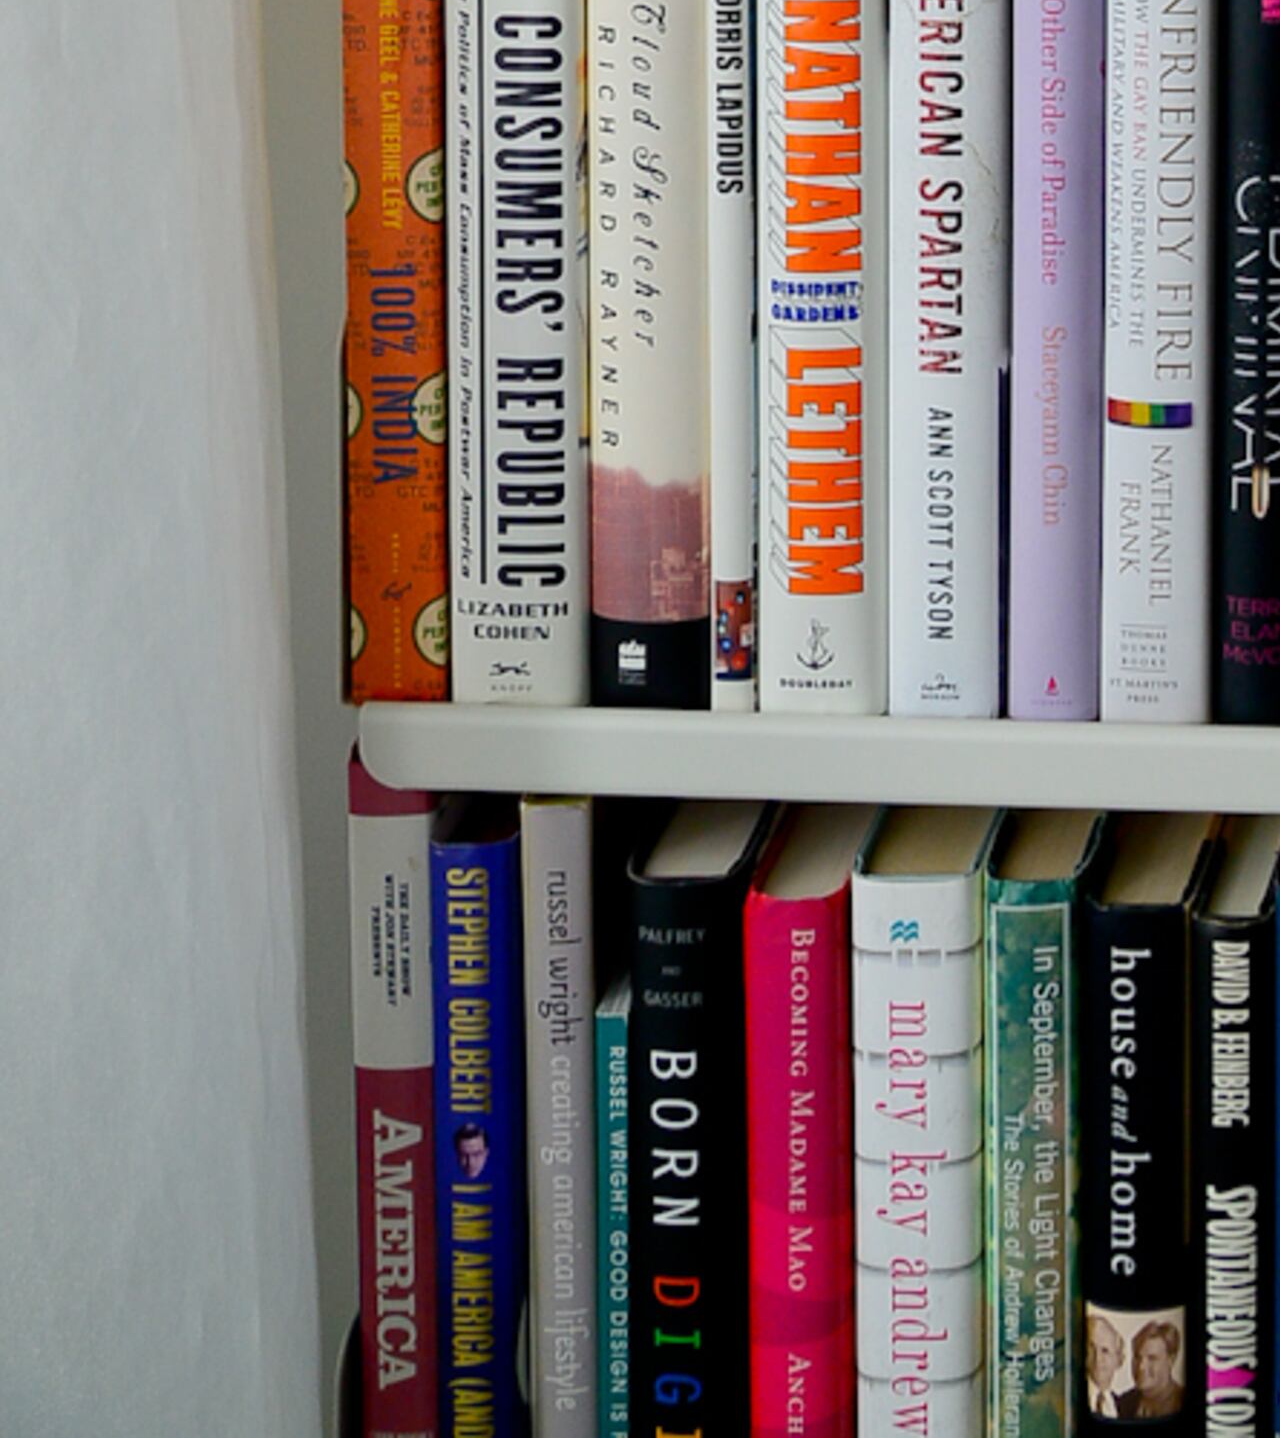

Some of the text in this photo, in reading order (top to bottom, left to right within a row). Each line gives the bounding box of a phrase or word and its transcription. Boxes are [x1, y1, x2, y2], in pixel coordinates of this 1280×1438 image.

[493, 16, 567, 334] CONSUMERS'
[715, 84, 745, 195] LAPIDUS
[495, 356, 567, 587] REPUBLIC
[928, 407, 953, 640] ANN SCOTT TYSON
[472, 623, 551, 642] COHEN
[445, 868, 492, 1115] STEPHEN COLBERT
[1108, 946, 1153, 1278] house and home
[372, 1108, 425, 1392] AMERICA
